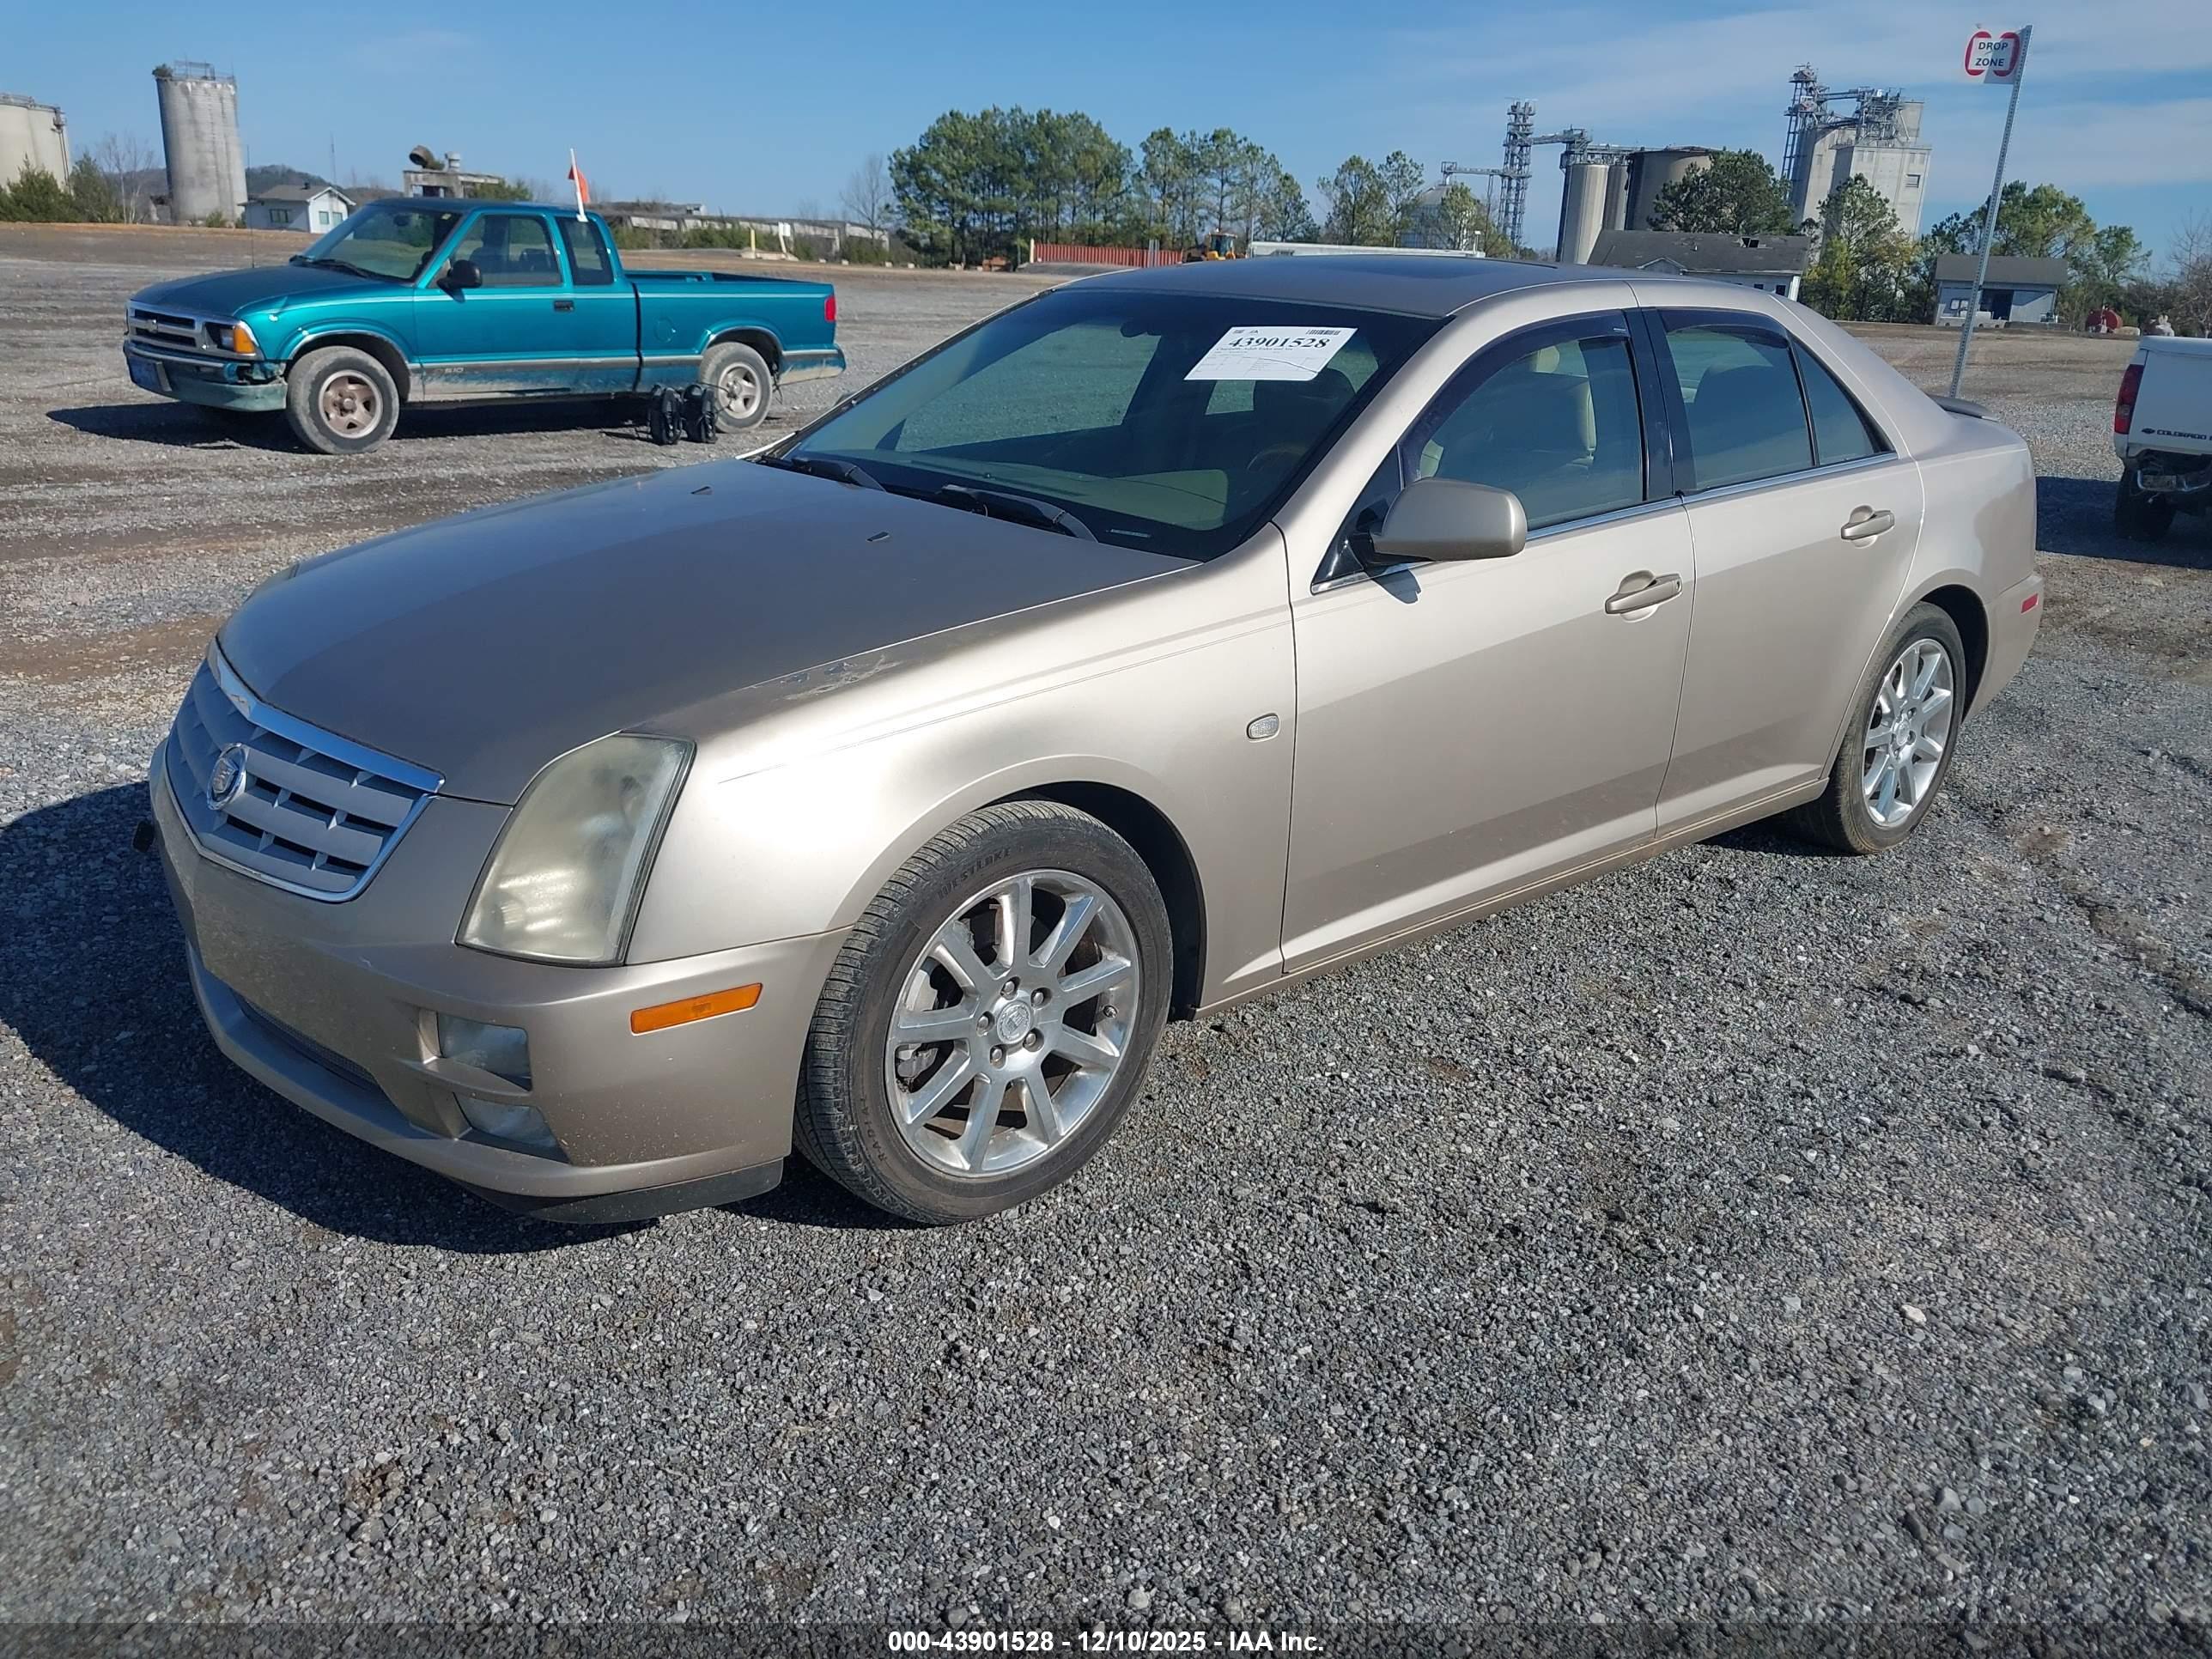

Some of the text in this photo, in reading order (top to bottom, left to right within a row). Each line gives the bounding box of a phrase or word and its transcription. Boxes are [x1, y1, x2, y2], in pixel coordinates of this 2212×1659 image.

[1978, 41, 2008, 51] DROP
[1975, 58, 2005, 67] ZONE
[1228, 337, 1331, 349] 43901528
[2156, 429, 2207, 441] COLORADO
